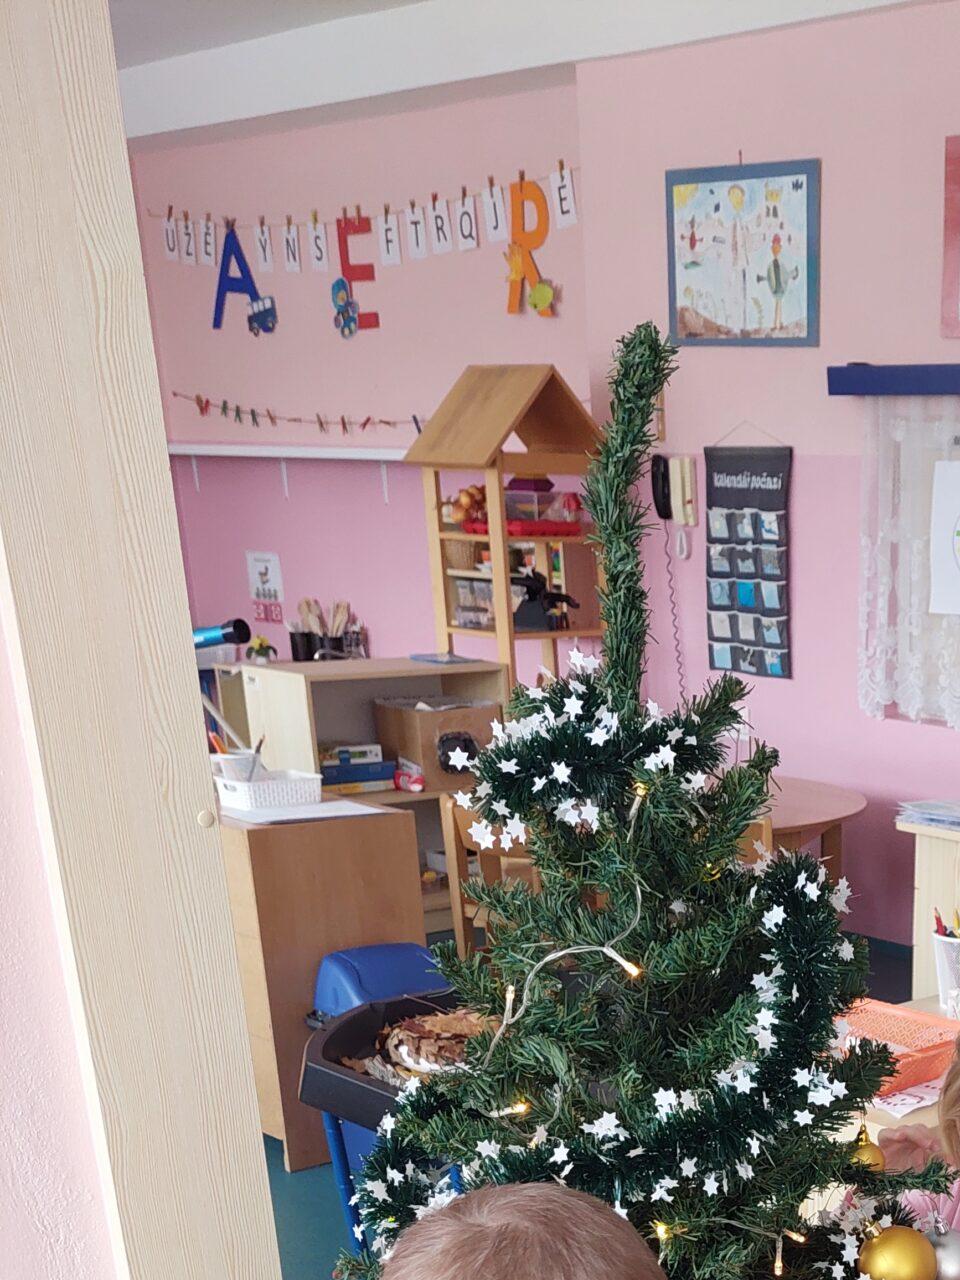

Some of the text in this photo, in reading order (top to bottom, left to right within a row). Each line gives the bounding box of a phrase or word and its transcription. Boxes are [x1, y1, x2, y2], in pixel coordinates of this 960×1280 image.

[165, 228, 176, 253] U
[212, 227, 275, 333] A
[285, 237, 297, 264] N
[314, 235, 323, 262] S
[336, 217, 380, 330] E
[384, 227, 394, 256] F
[409, 220, 421, 249] T
[434, 213, 448, 244] R
[459, 210, 476, 241] Q
[508, 180, 556, 318] R
